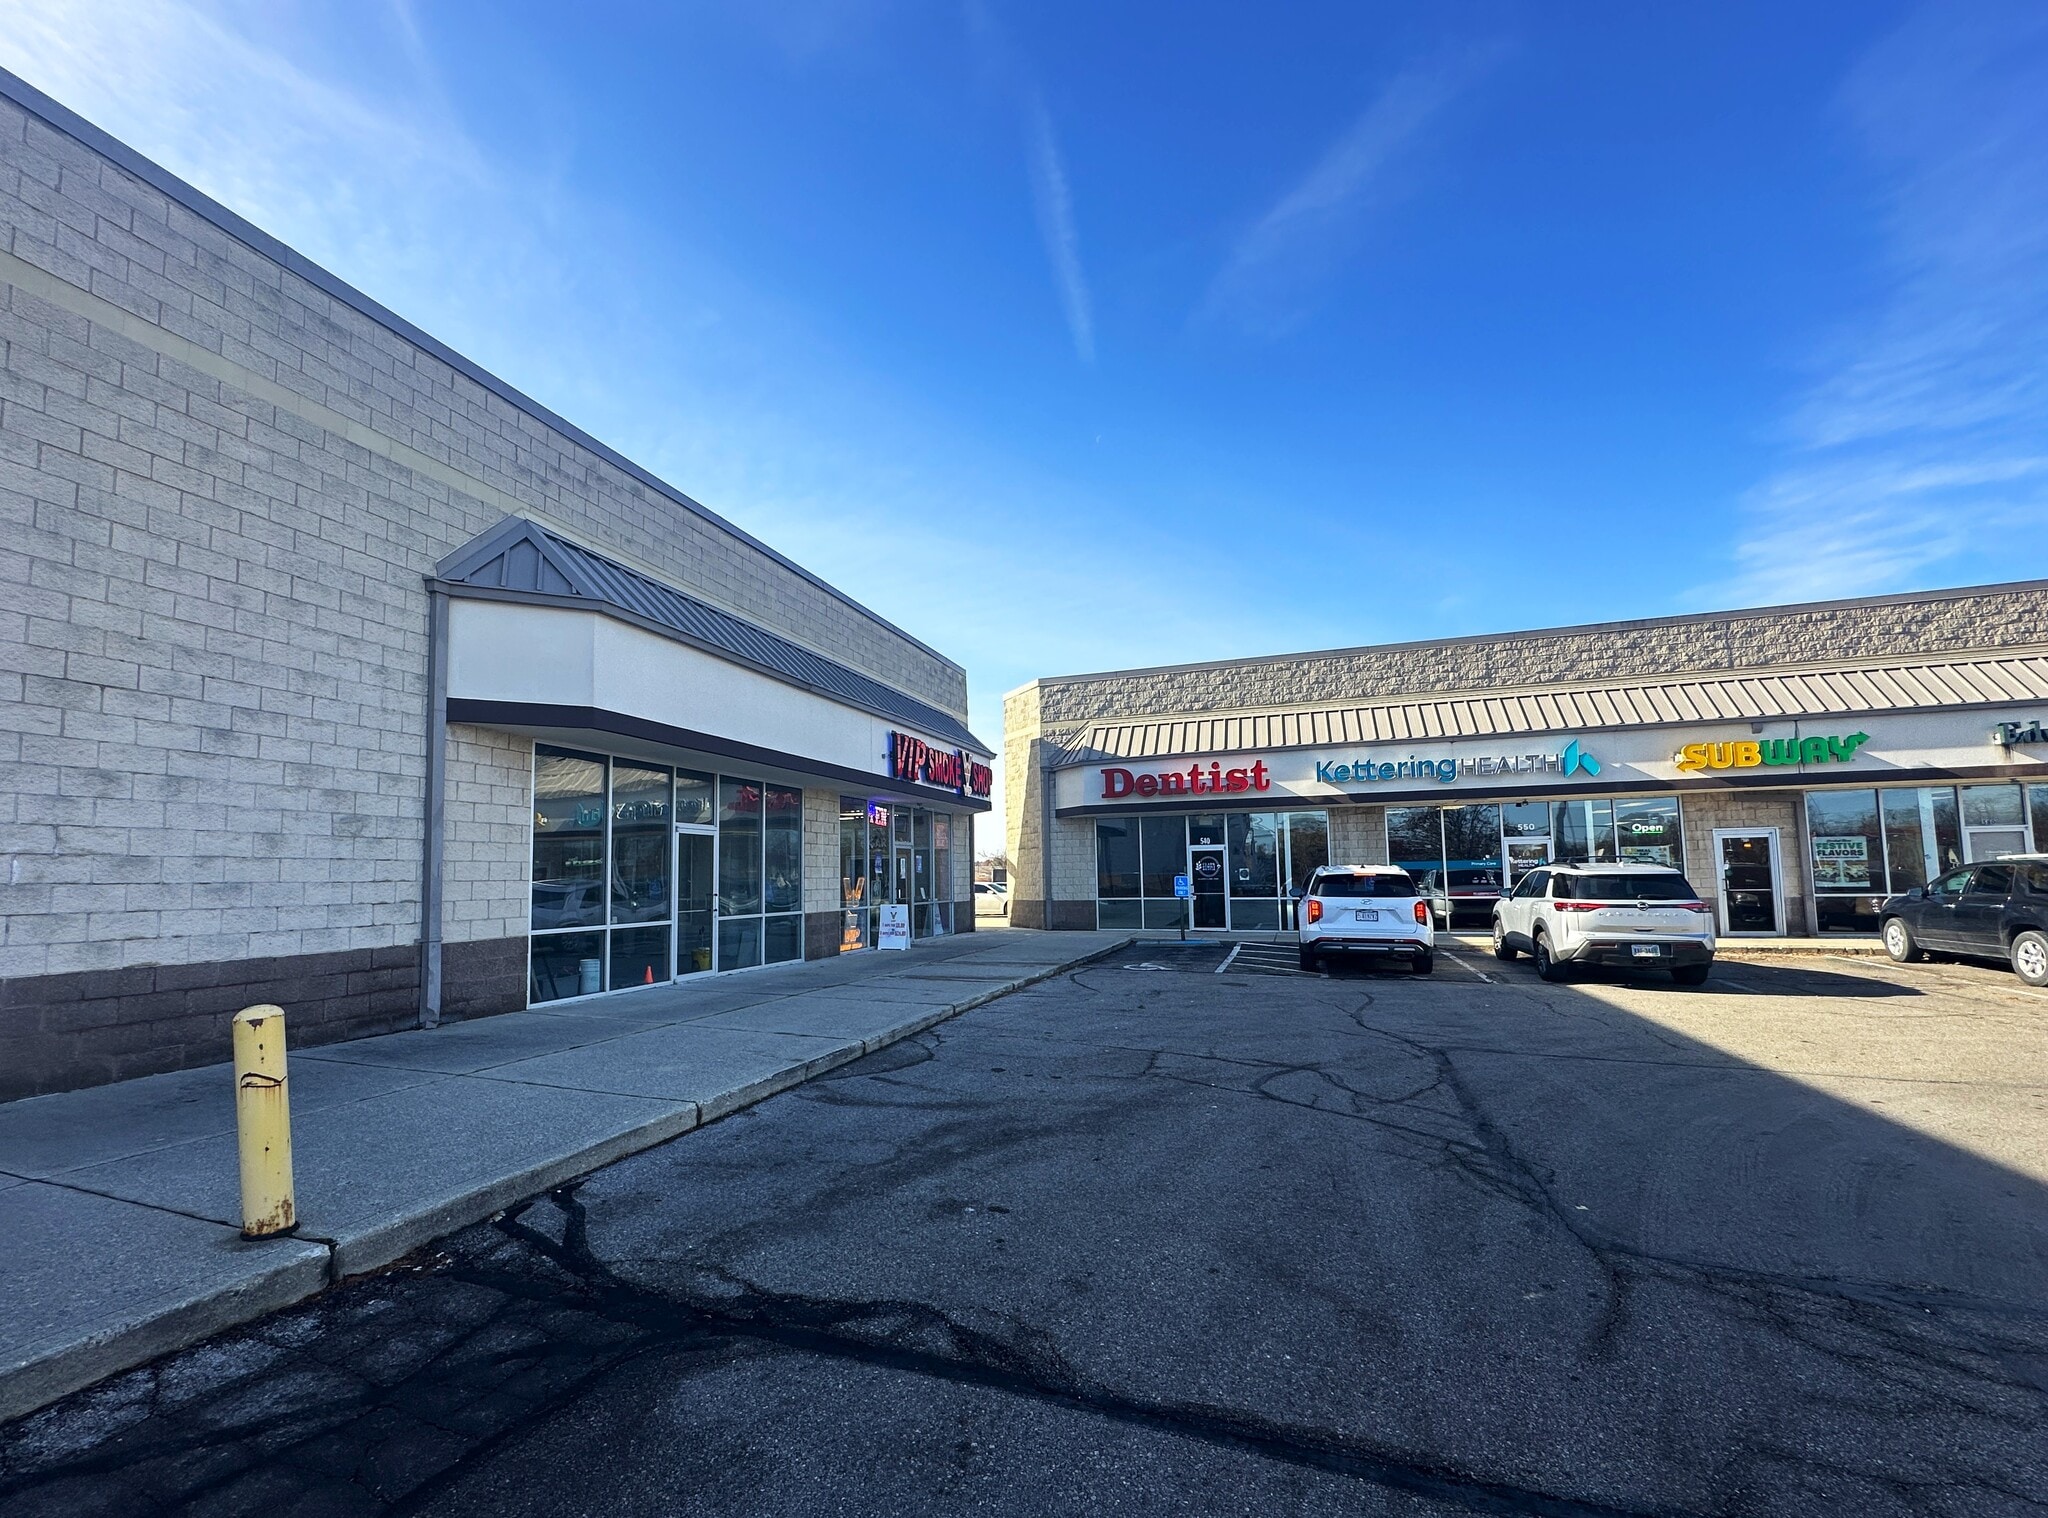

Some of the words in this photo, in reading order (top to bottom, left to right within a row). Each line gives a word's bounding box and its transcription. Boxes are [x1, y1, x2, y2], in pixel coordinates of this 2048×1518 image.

[1997, 720, 2048, 745] Ed
[893, 731, 927, 781] VIP
[927, 747, 962, 788] SMOKE
[972, 761, 992, 796] SHOP
[1676, 731, 1870, 772] SUBWAY
[1101, 760, 1270, 798] Dentist
[1316, 755, 1457, 782] Kettering
[1459, 753, 1562, 776] HEALTH
[1517, 823, 1535, 831] 550
[1632, 823, 1663, 833] Open
[1200, 837, 1211, 845] 540
